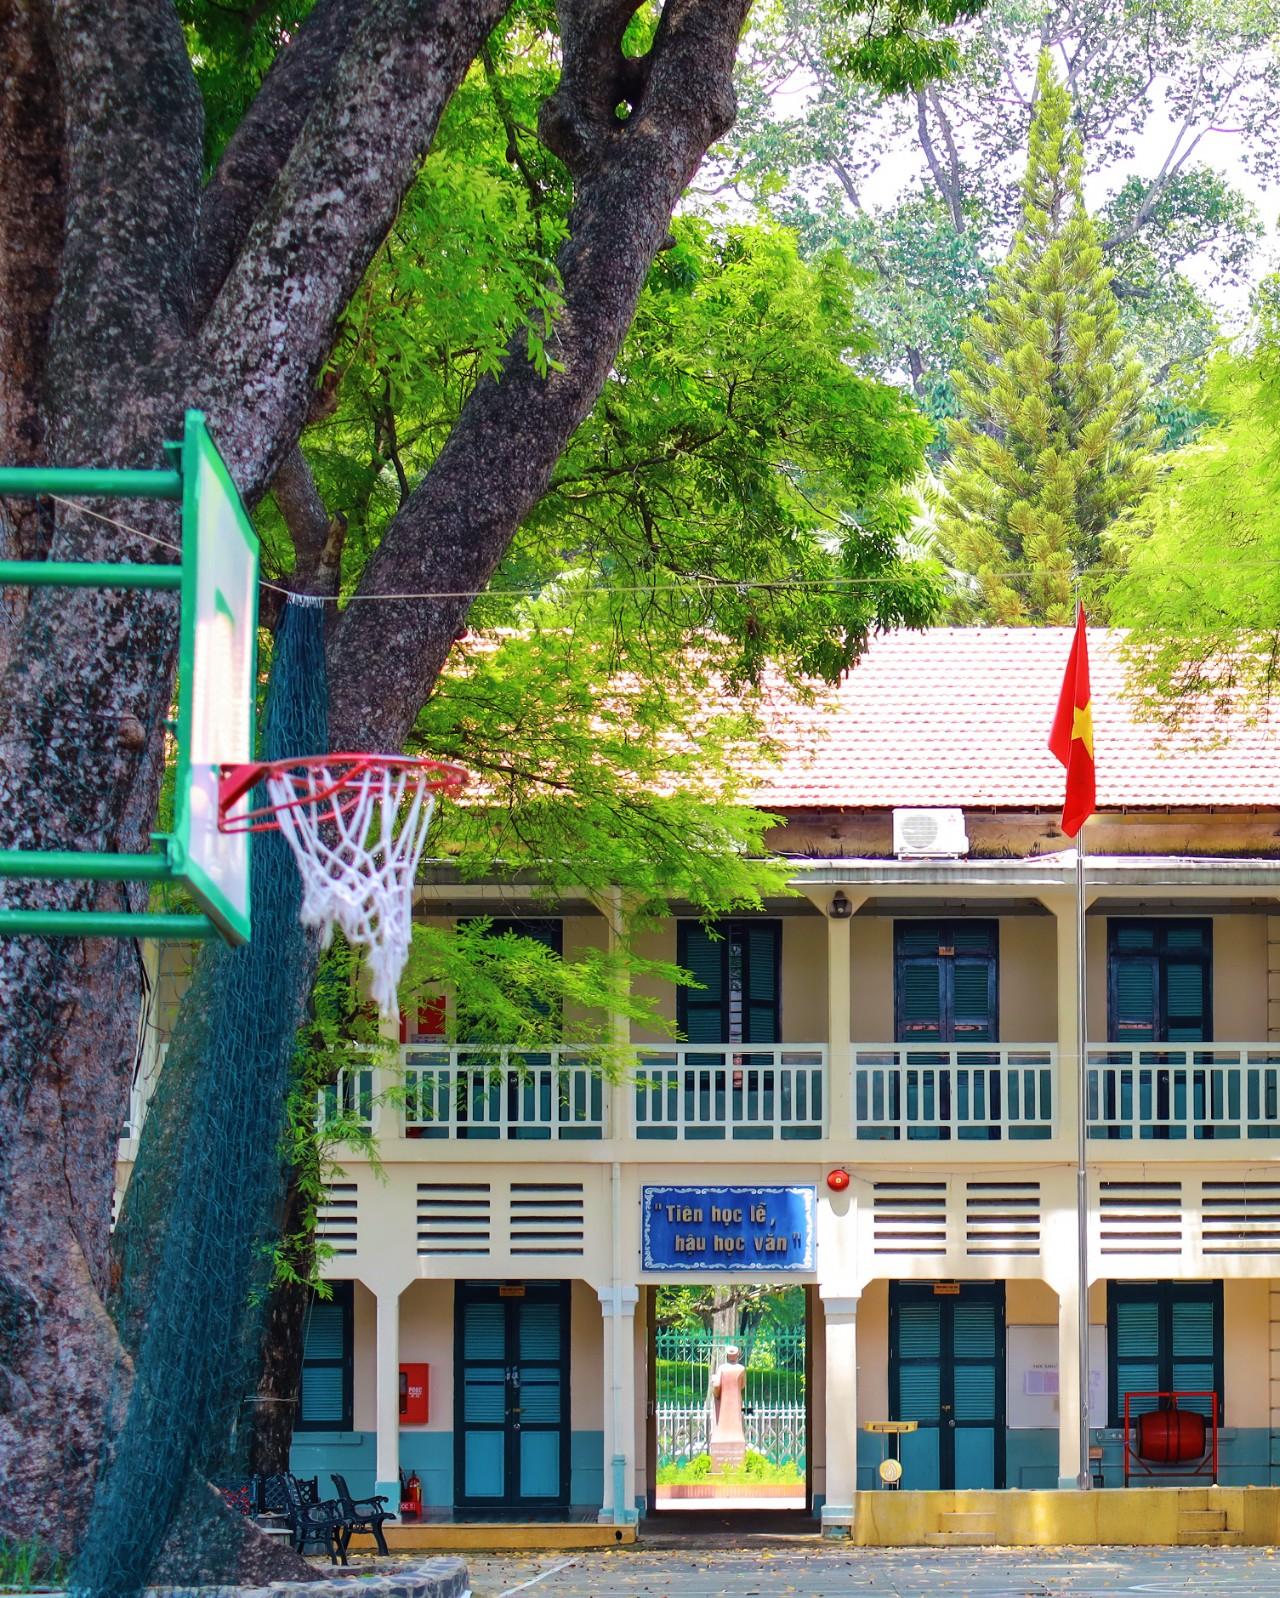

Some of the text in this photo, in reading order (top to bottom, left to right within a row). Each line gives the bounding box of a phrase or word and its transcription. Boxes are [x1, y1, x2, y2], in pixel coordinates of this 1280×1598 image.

[711, 1205, 743, 1226] học
[675, 1233, 706, 1256] hậu
[714, 1234, 745, 1257] học
